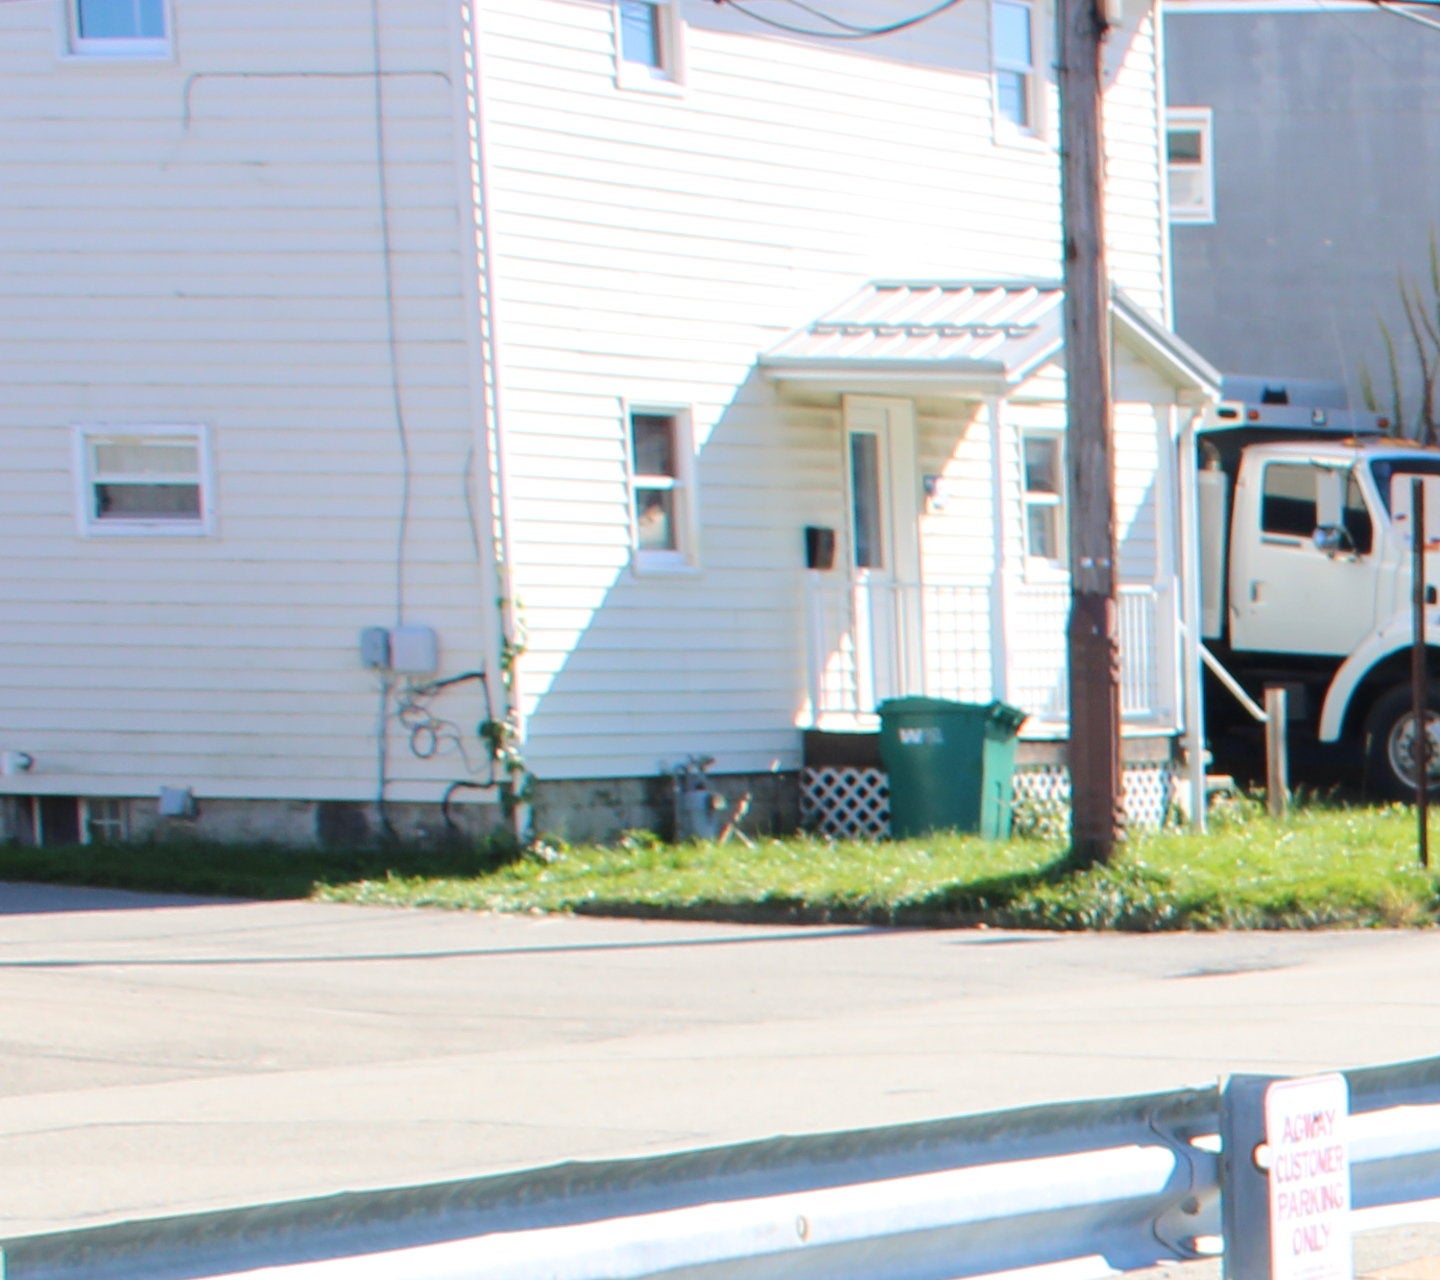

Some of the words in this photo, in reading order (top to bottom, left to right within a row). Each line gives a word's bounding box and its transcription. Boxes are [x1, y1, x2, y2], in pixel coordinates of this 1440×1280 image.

[1283, 1109, 1336, 1144] AGWAY
[1275, 1145, 1344, 1184] CUSTOMER
[1277, 1183, 1345, 1221] PARKING
[1293, 1222, 1332, 1256] ONLY
